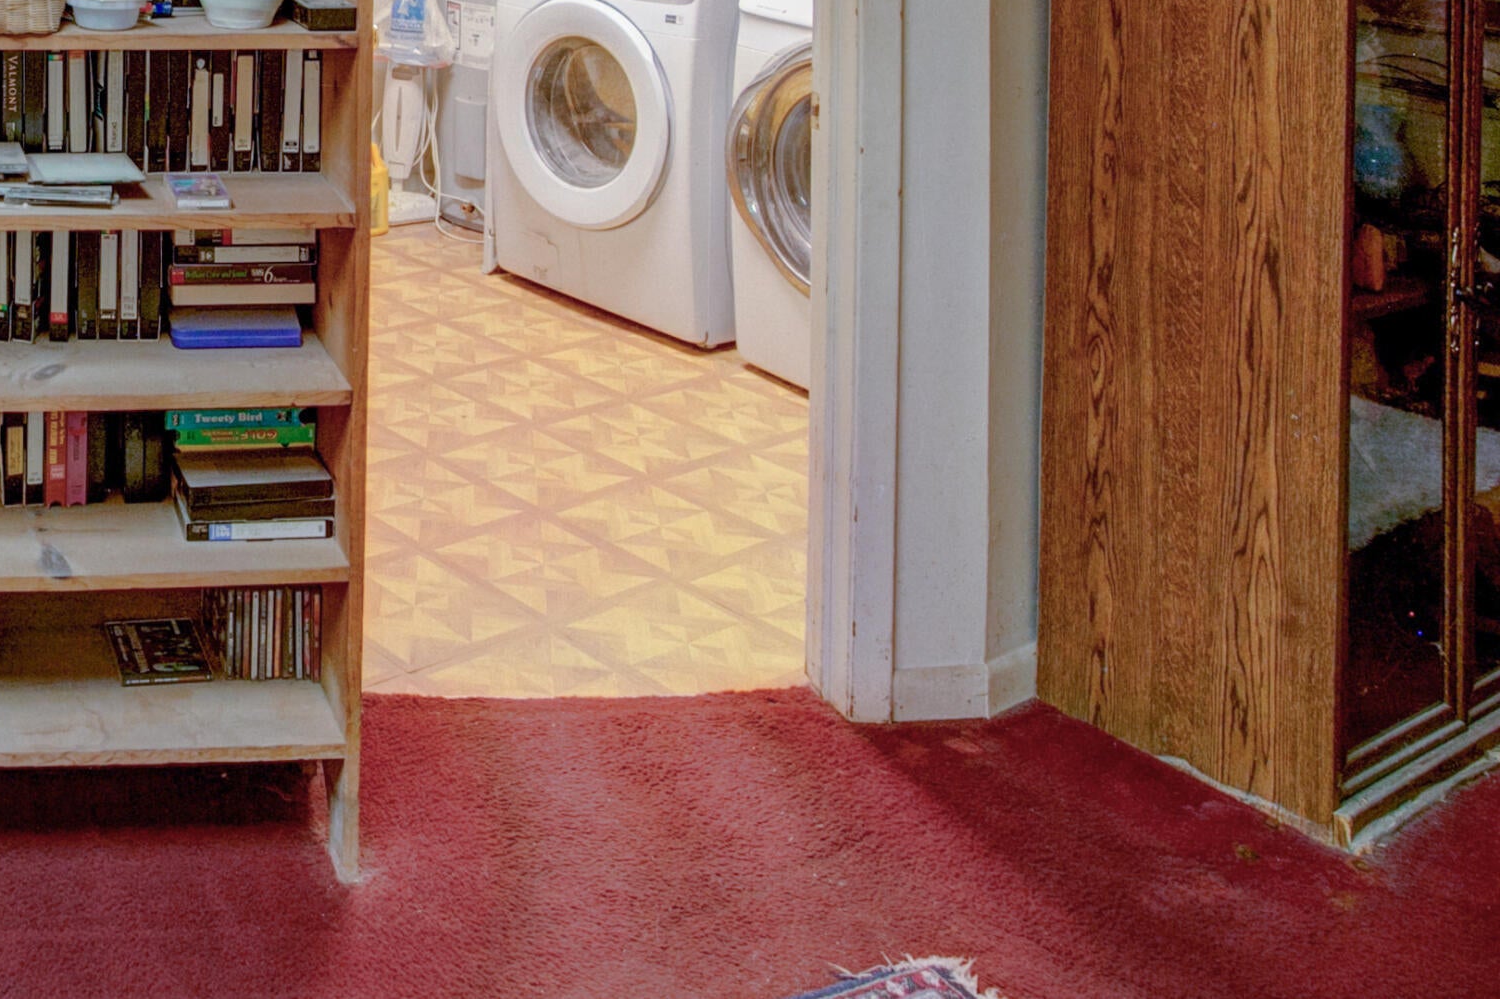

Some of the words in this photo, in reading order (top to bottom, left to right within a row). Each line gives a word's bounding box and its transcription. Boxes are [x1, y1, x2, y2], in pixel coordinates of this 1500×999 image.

[7, 55, 19, 113] VALMONT
[263, 266, 274, 284] 6
[194, 412, 236, 424] Tweety
[238, 411, 263, 422] Bird
[239, 430, 278, 441] GOLF
